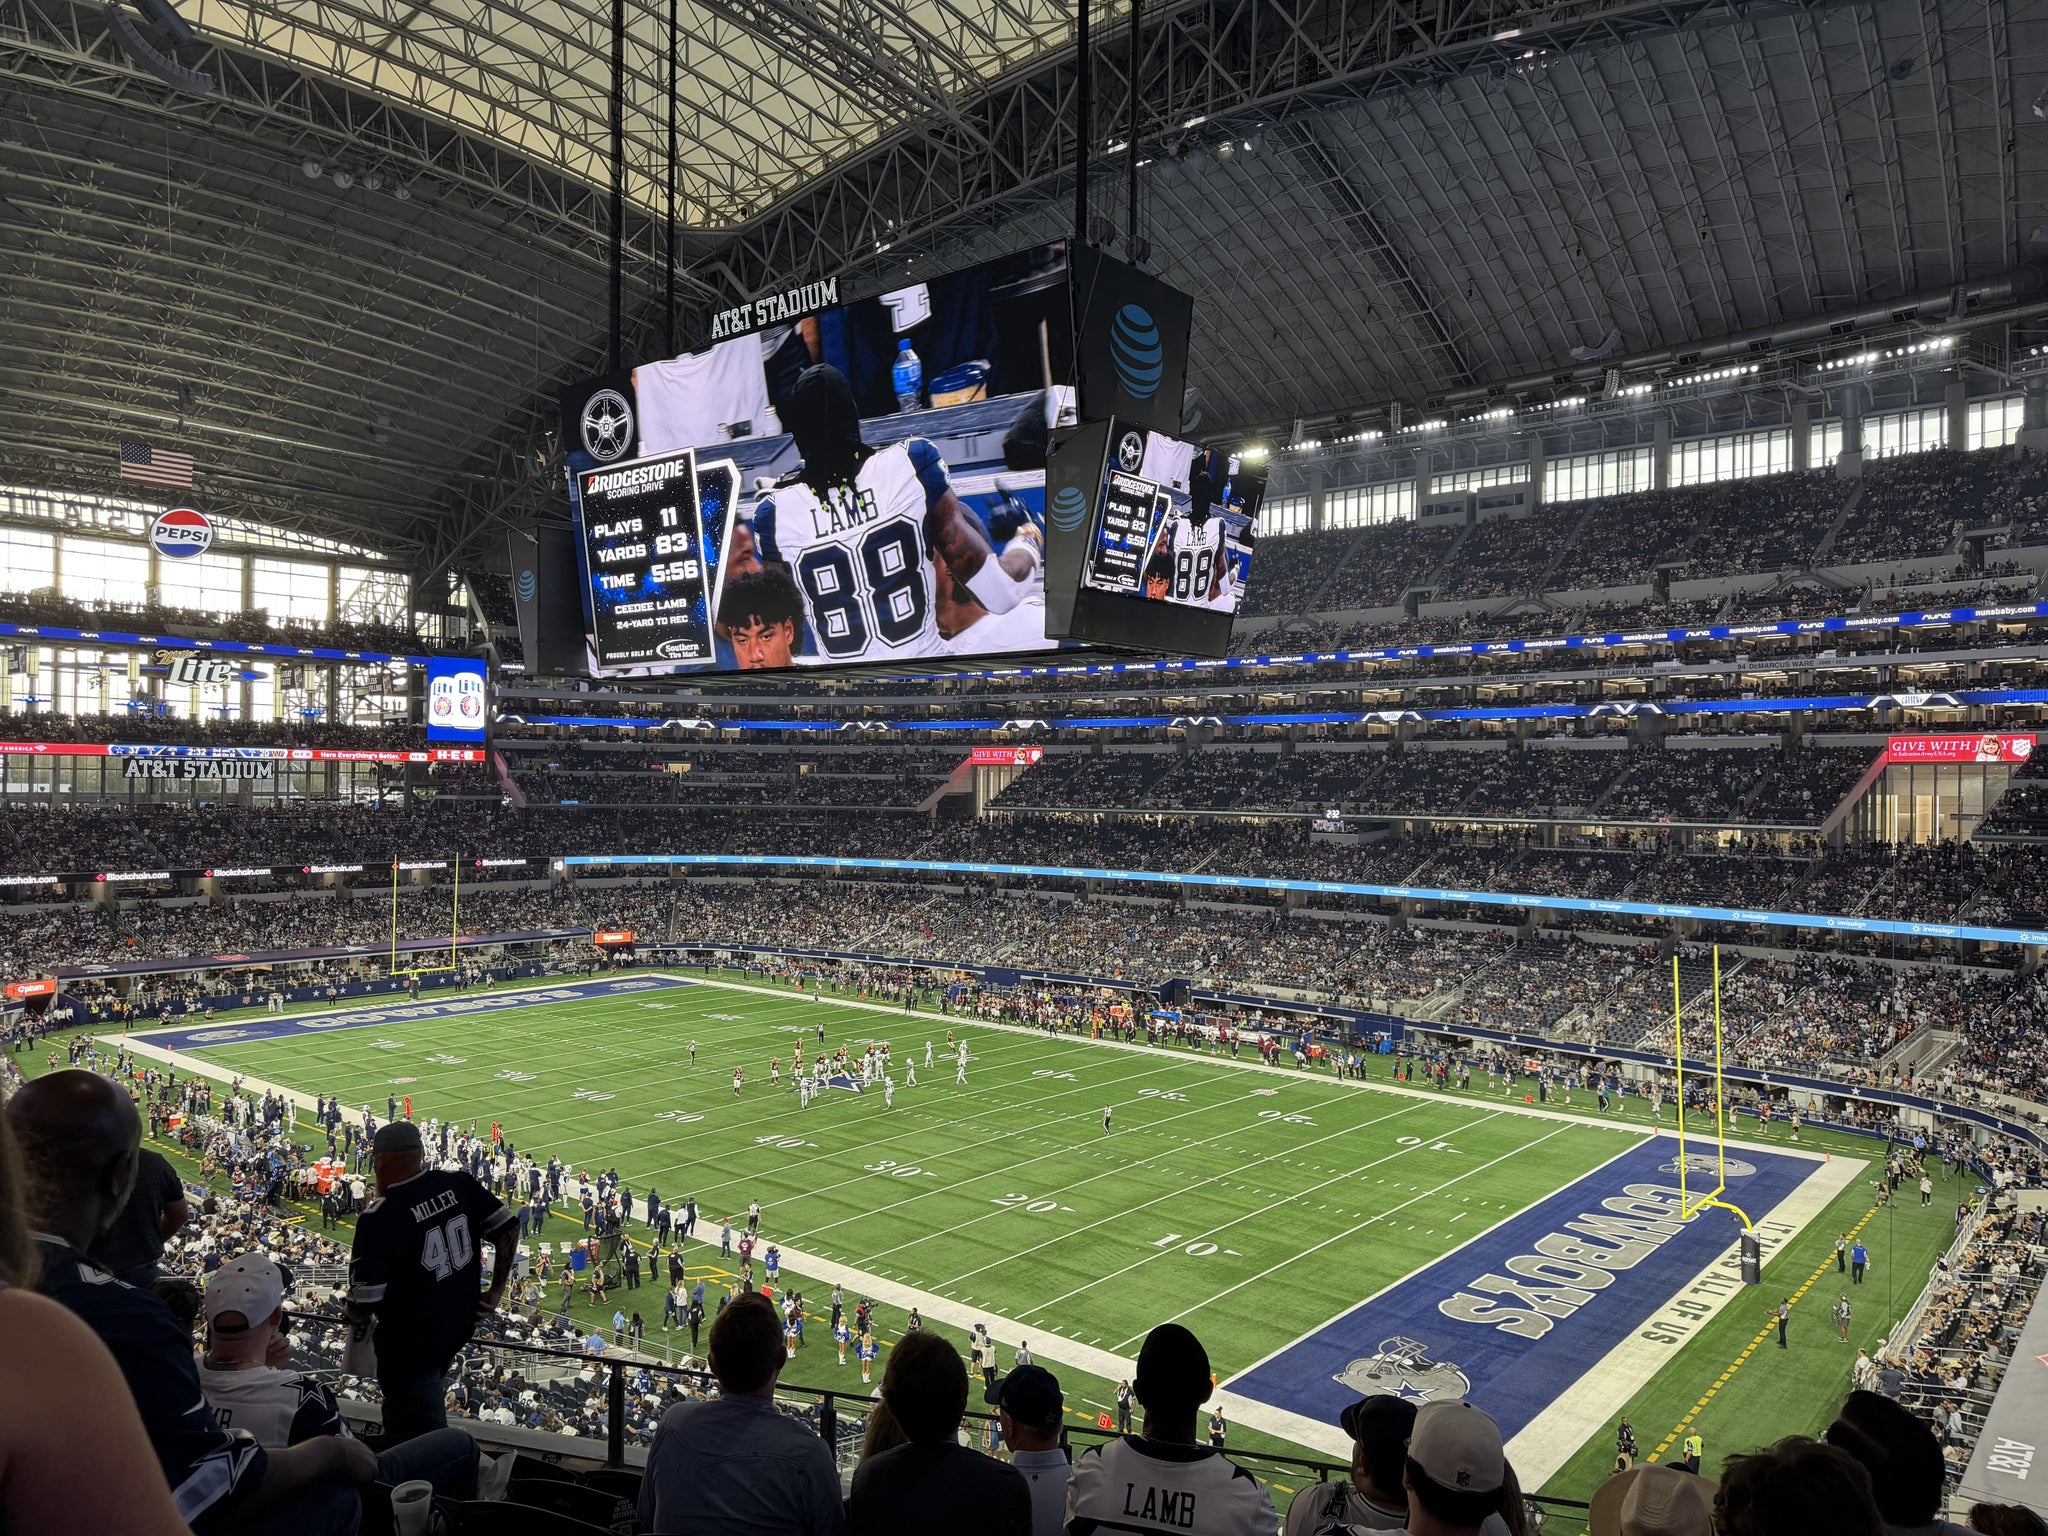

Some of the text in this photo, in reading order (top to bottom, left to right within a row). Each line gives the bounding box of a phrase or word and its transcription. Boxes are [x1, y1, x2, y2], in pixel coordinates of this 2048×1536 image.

[711, 277, 838, 339] AT&T STADIUM
[587, 459, 684, 494] BRIDGESTONE
[1112, 474, 1156, 495] BRIDGESTONE
[606, 480, 665, 500] SCORING DRIVE
[809, 487, 878, 539] LAMB
[1109, 502, 1146, 518] PLAYS 11
[594, 506, 678, 538] PLAYS 11
[1107, 516, 1147, 532] YARDS 83
[155, 526, 209, 542] PEPSI
[1104, 530, 1147, 547] TIME 5:56
[597, 532, 688, 562] YARDS 83
[600, 560, 699, 589] TIME 5:56
[1175, 547, 1215, 601] 88
[793, 514, 932, 658] 88
[614, 598, 687, 615] CEEDEE LAMB
[616, 618, 654, 629] 24-YARD
[670, 615, 689, 624] REC
[1348, 651, 1385, 659] nunababy.com
[1433, 645, 1473, 654] nunababy.com
[1525, 639, 1567, 648] nunababy.com
[1623, 632, 1668, 641] nunababy.com
[1729, 624, 1778, 634] nunababy.com
[1846, 616, 1900, 626] nunababy.com
[1975, 606, 2036, 617] nunababy.com
[606, 651, 629, 659] PROUDLY
[665, 643, 699, 651] Southern
[164, 657, 232, 687] Lite
[1749, 661, 1791, 669] DeMARCUS
[128, 746, 139, 754] 37
[187, 748, 206, 756] 2:32
[973, 750, 991, 758] GIVE
[992, 750, 1012, 758] WITH
[1892, 742, 1926, 751] GIVE
[1928, 741, 1970, 751] WITH
[1972, 740, 2011, 753] JY
[320, 751, 337, 759] Here
[338, 751, 378, 760] Everything's
[125, 759, 273, 779] AT&T STADIUM
[311, 864, 363, 873] Blockchain.com
[399, 861, 447, 869] Blockchain.com
[482, 858, 527, 866] Blockchain.com
[106, 871, 170, 881] Blockchain.com
[213, 868, 271, 877] Blockchain.com
[1519, 896, 1542, 905] invisalign
[1598, 902, 1623, 910] invisalign
[1666, 907, 1692, 916] invisalign
[1741, 911, 1769, 921] invisalign
[1837, 919, 1867, 929] invisalign
[1922, 925, 1956, 935] invisalign
[2032, 933, 2048, 942] invis
[18, 983, 45, 993] Optum
[297, 989, 583, 1028] COWBOYS
[654, 1110, 705, 1124] 50
[753, 1134, 805, 1149] 40
[863, 1160, 922, 1178] 30
[410, 1189, 459, 1223] MILLER
[990, 1192, 1057, 1214] 20
[1761, 1221, 1796, 1234] IT
[420, 1213, 474, 1282] 40
[1146, 1232, 1219, 1257] 10
[1438, 1183, 1719, 1340] COWBOYS
[1689, 1271, 1741, 1297] ALL
[1670, 1300, 1712, 1321] OF
[1641, 1321, 1690, 1345] US
[1100, 1414, 1107, 1426] G
[1986, 1436, 2036, 1480] AT&T
[1122, 1482, 1196, 1529] LAMB
